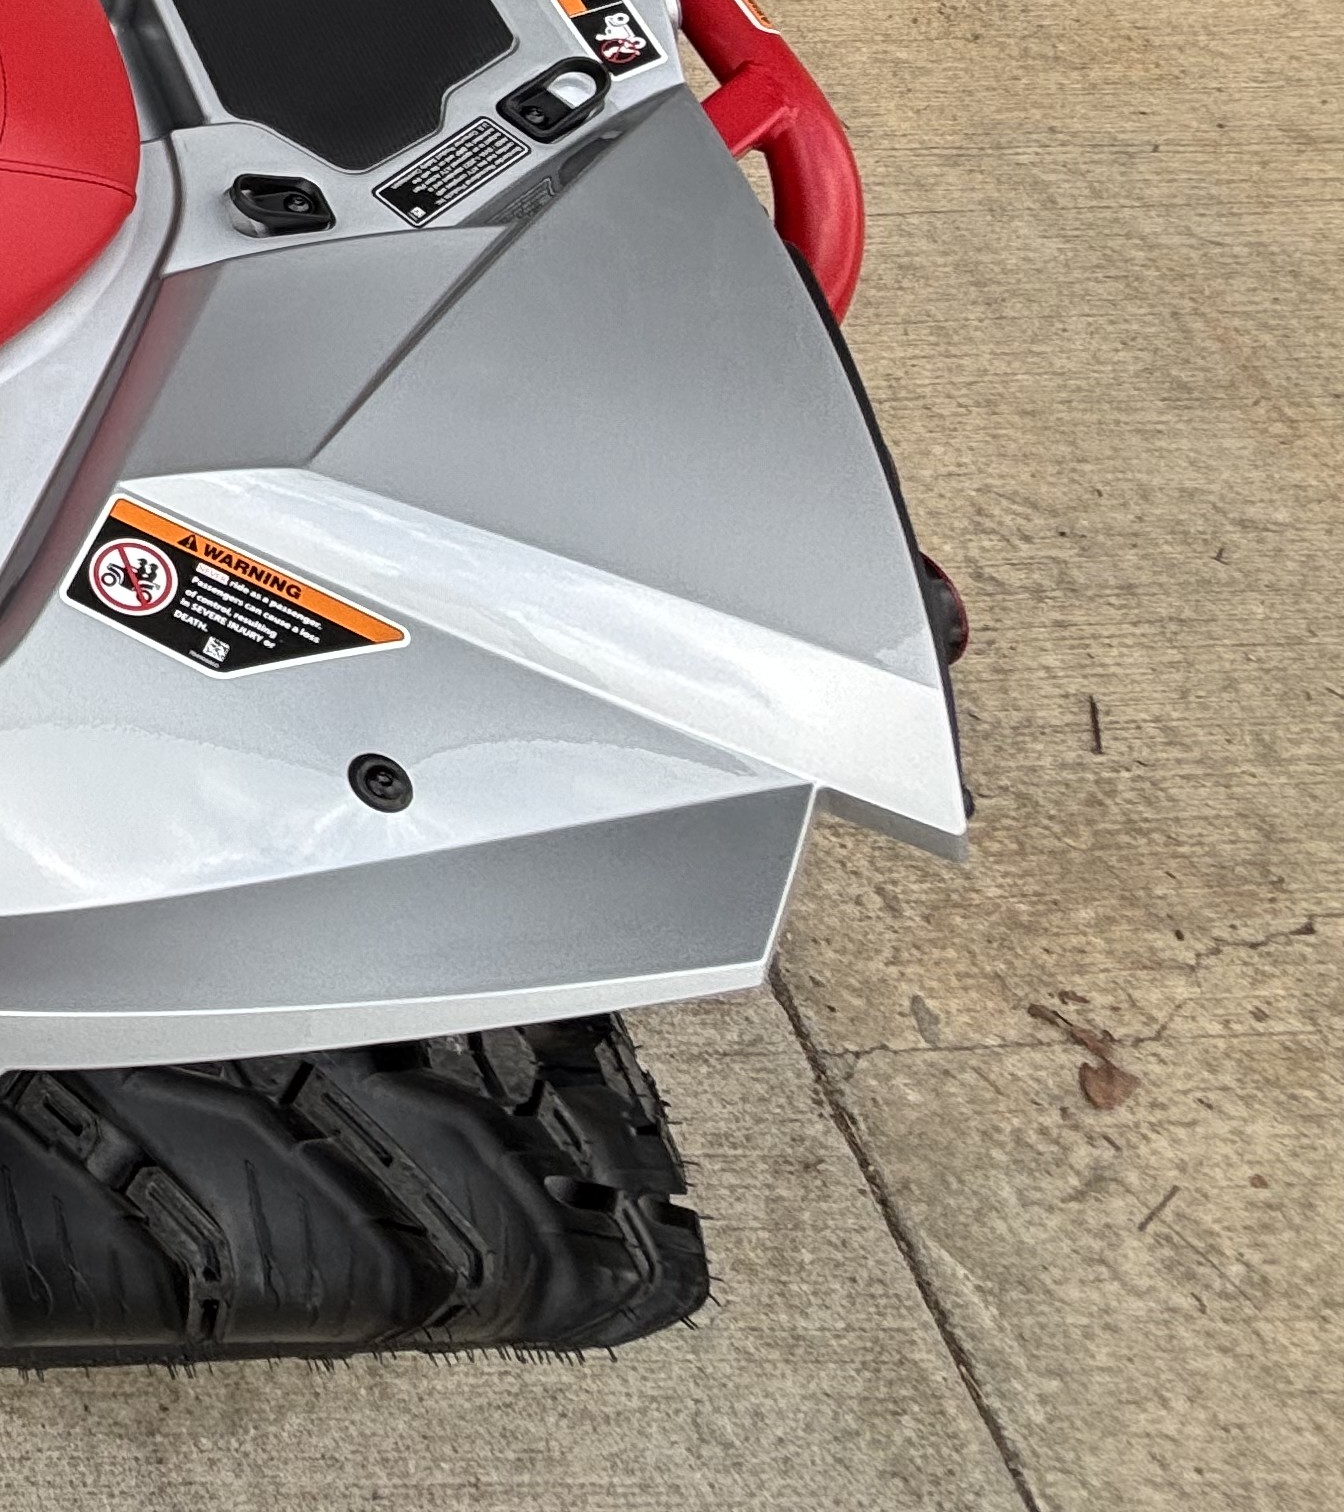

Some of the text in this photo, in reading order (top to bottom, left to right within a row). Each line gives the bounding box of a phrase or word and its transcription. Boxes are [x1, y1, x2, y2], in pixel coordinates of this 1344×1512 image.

[196, 563, 228, 584] NEVER
[229, 581, 249, 594] ride
[250, 591, 261, 600] as
[269, 601, 321, 630] passenger.
[203, 543, 302, 600] WARNING
[174, 610, 207, 632] DEATH.
[180, 598, 275, 648] in SEVERE INJURY or
[185, 590, 277, 639] of control, resulting
[192, 576, 243, 606] Passengers
[244, 603, 262, 615] can
[263, 612, 291, 629] cause
[299, 628, 320, 643] loss
